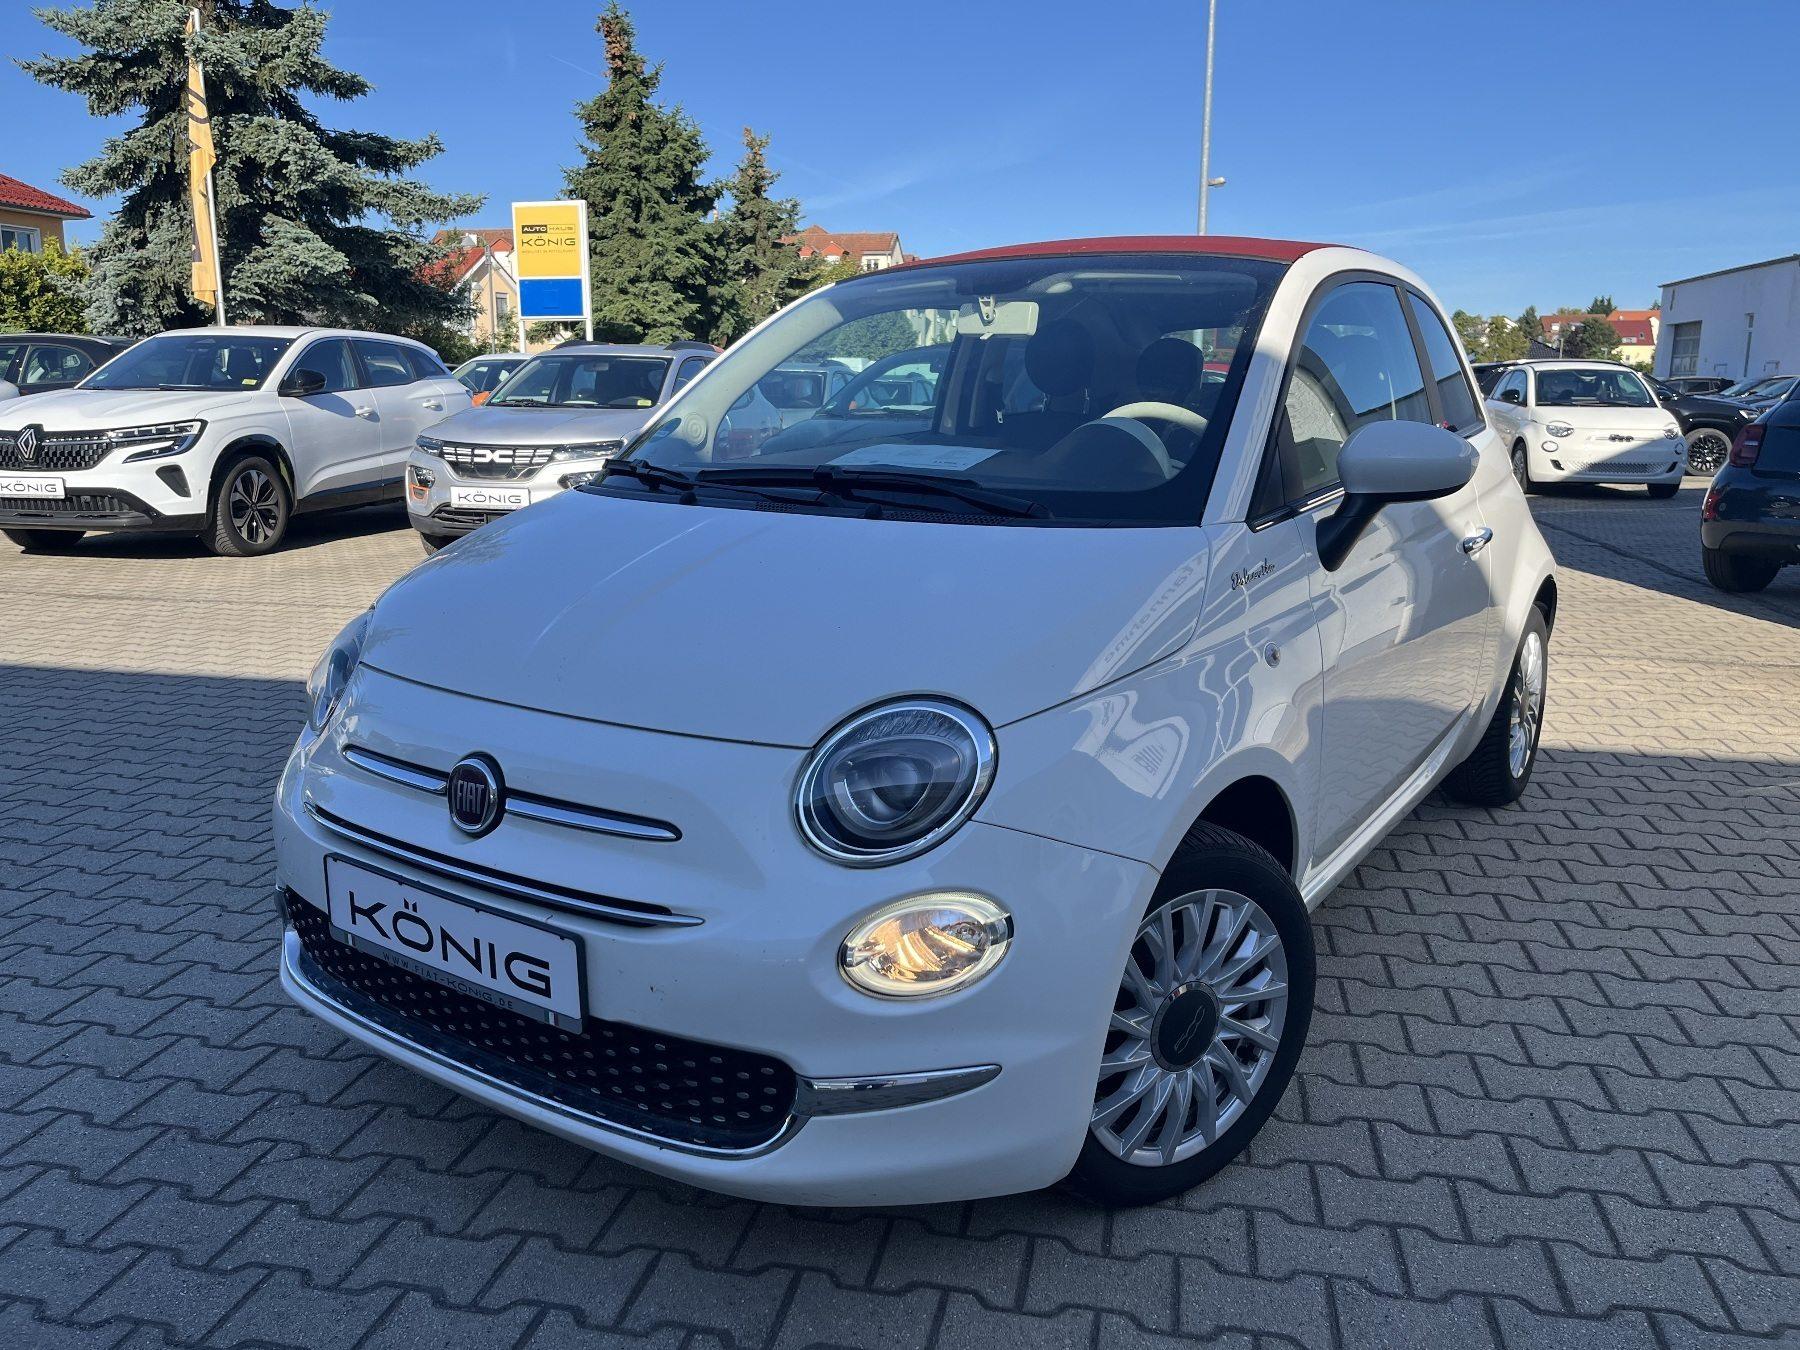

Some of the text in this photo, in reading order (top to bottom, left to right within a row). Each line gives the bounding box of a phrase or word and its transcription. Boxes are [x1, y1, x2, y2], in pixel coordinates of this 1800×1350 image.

[521, 235, 576, 247] KÖNIG
[0, 480, 57, 493] KÖNIG
[457, 490, 522, 504] KÖNIG
[457, 779, 485, 815] FIAT
[349, 890, 552, 999] KÖNIG
